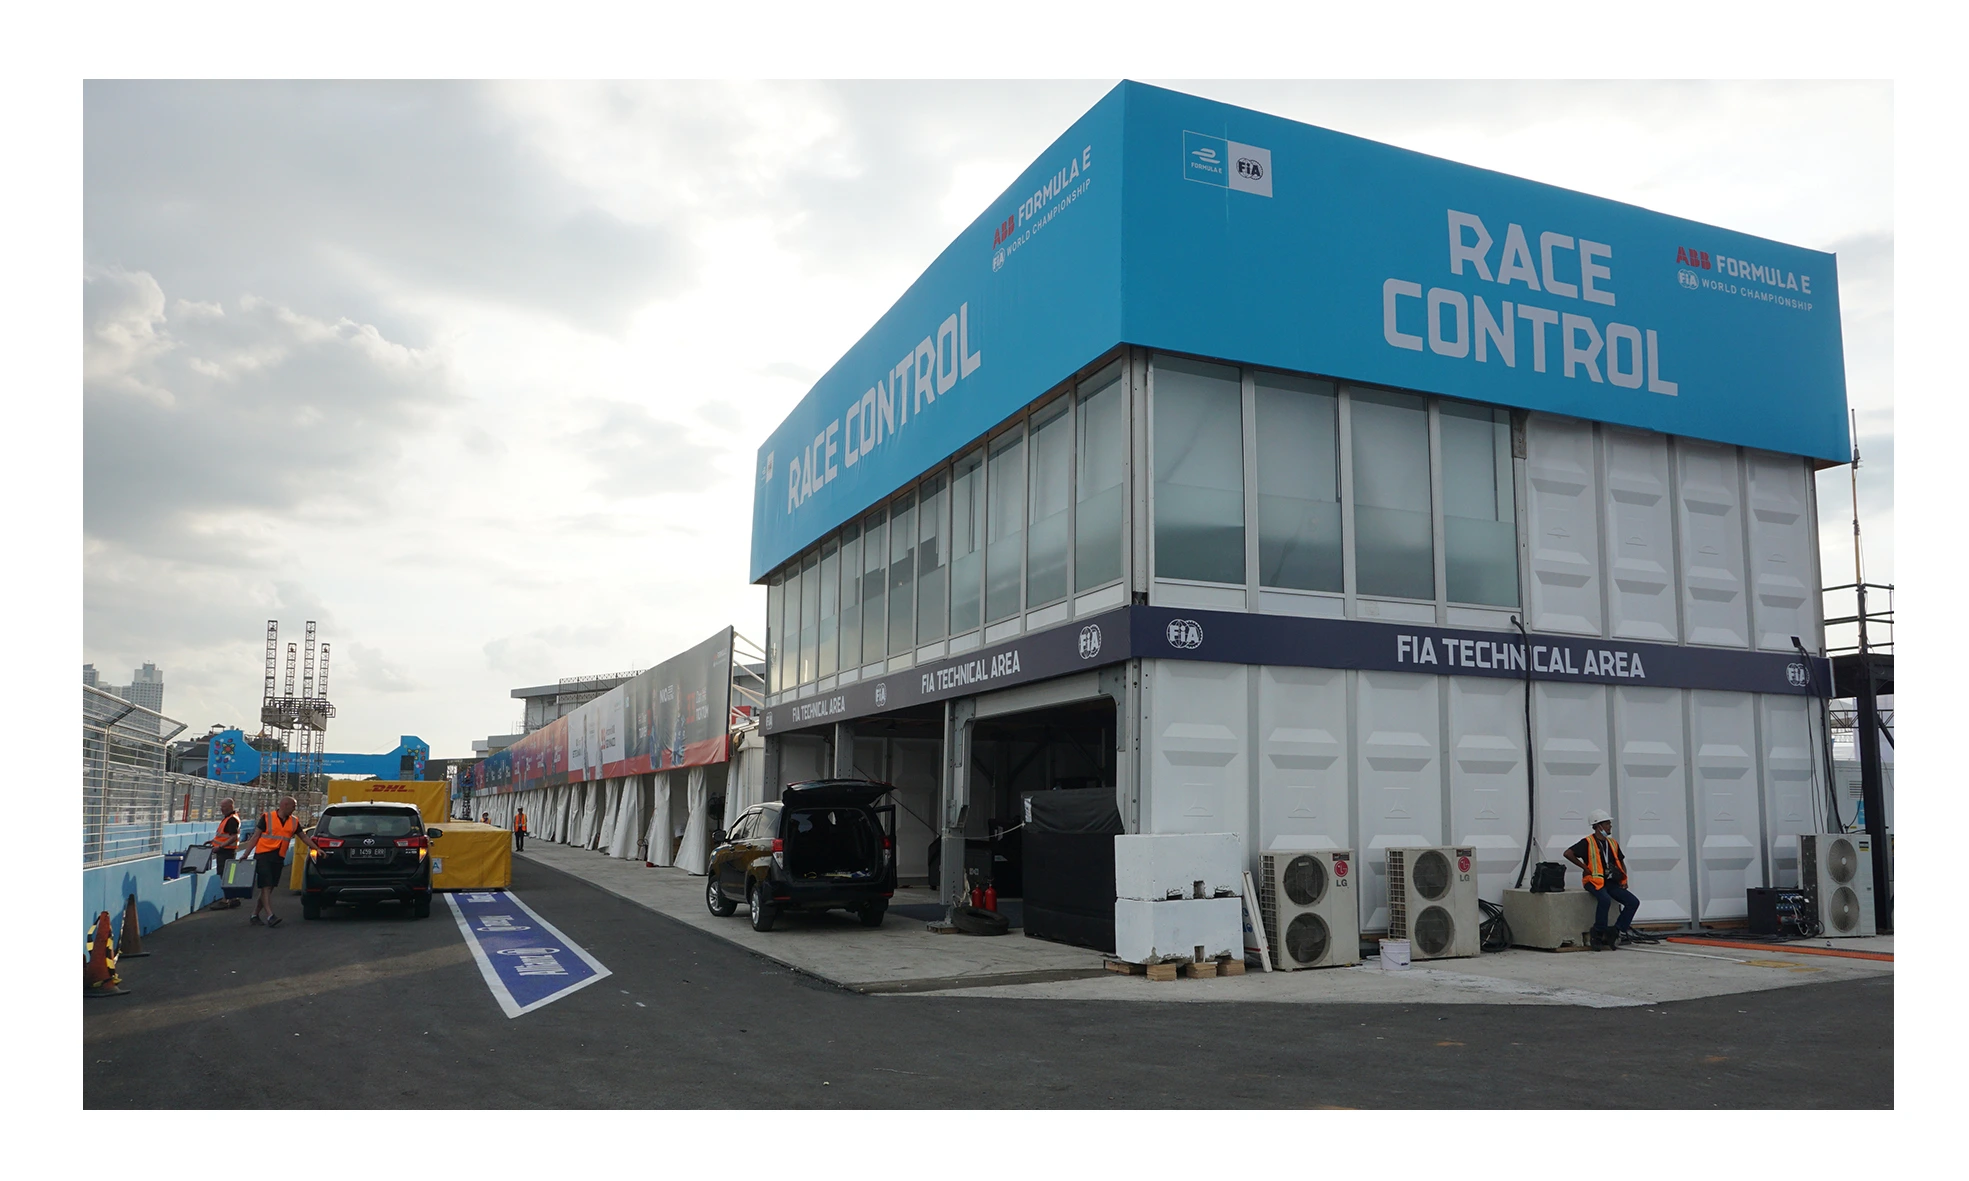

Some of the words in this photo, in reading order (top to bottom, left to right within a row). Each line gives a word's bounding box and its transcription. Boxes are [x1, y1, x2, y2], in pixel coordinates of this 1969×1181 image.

[1191, 162, 1218, 173] FORMULA
[992, 214, 1015, 250] ABB
[1018, 157, 1079, 227] FORMULA
[1082, 145, 1091, 171] E
[1006, 230, 1030, 256] WORLD
[1032, 178, 1090, 234] CHAMPIONSHIP
[1447, 209, 1616, 307] RACE
[1676, 246, 1711, 270] ABB
[1716, 255, 1798, 291] FORMULA
[1801, 275, 1811, 294] E
[1702, 279, 1737, 294] WORLD
[1741, 287, 1813, 311] CHAMPIONSHIP
[1383, 278, 1679, 397] CONTROL
[787, 418, 839, 515] RACE
[844, 301, 981, 469] CONTROL
[921, 672, 935, 694] FIA
[936, 659, 989, 691] TECHNICAL
[990, 650, 1021, 679] AREA
[1397, 635, 1438, 665] FIA
[1583, 649, 1646, 678] AREA
[792, 706, 801, 722] FIA
[801, 700, 829, 720] TECHNICAL
[829, 695, 846, 715] AREA
[371, 784, 408, 793] DHL
[1336, 879, 1347, 887] LG
[1460, 874, 1470, 882] LG
